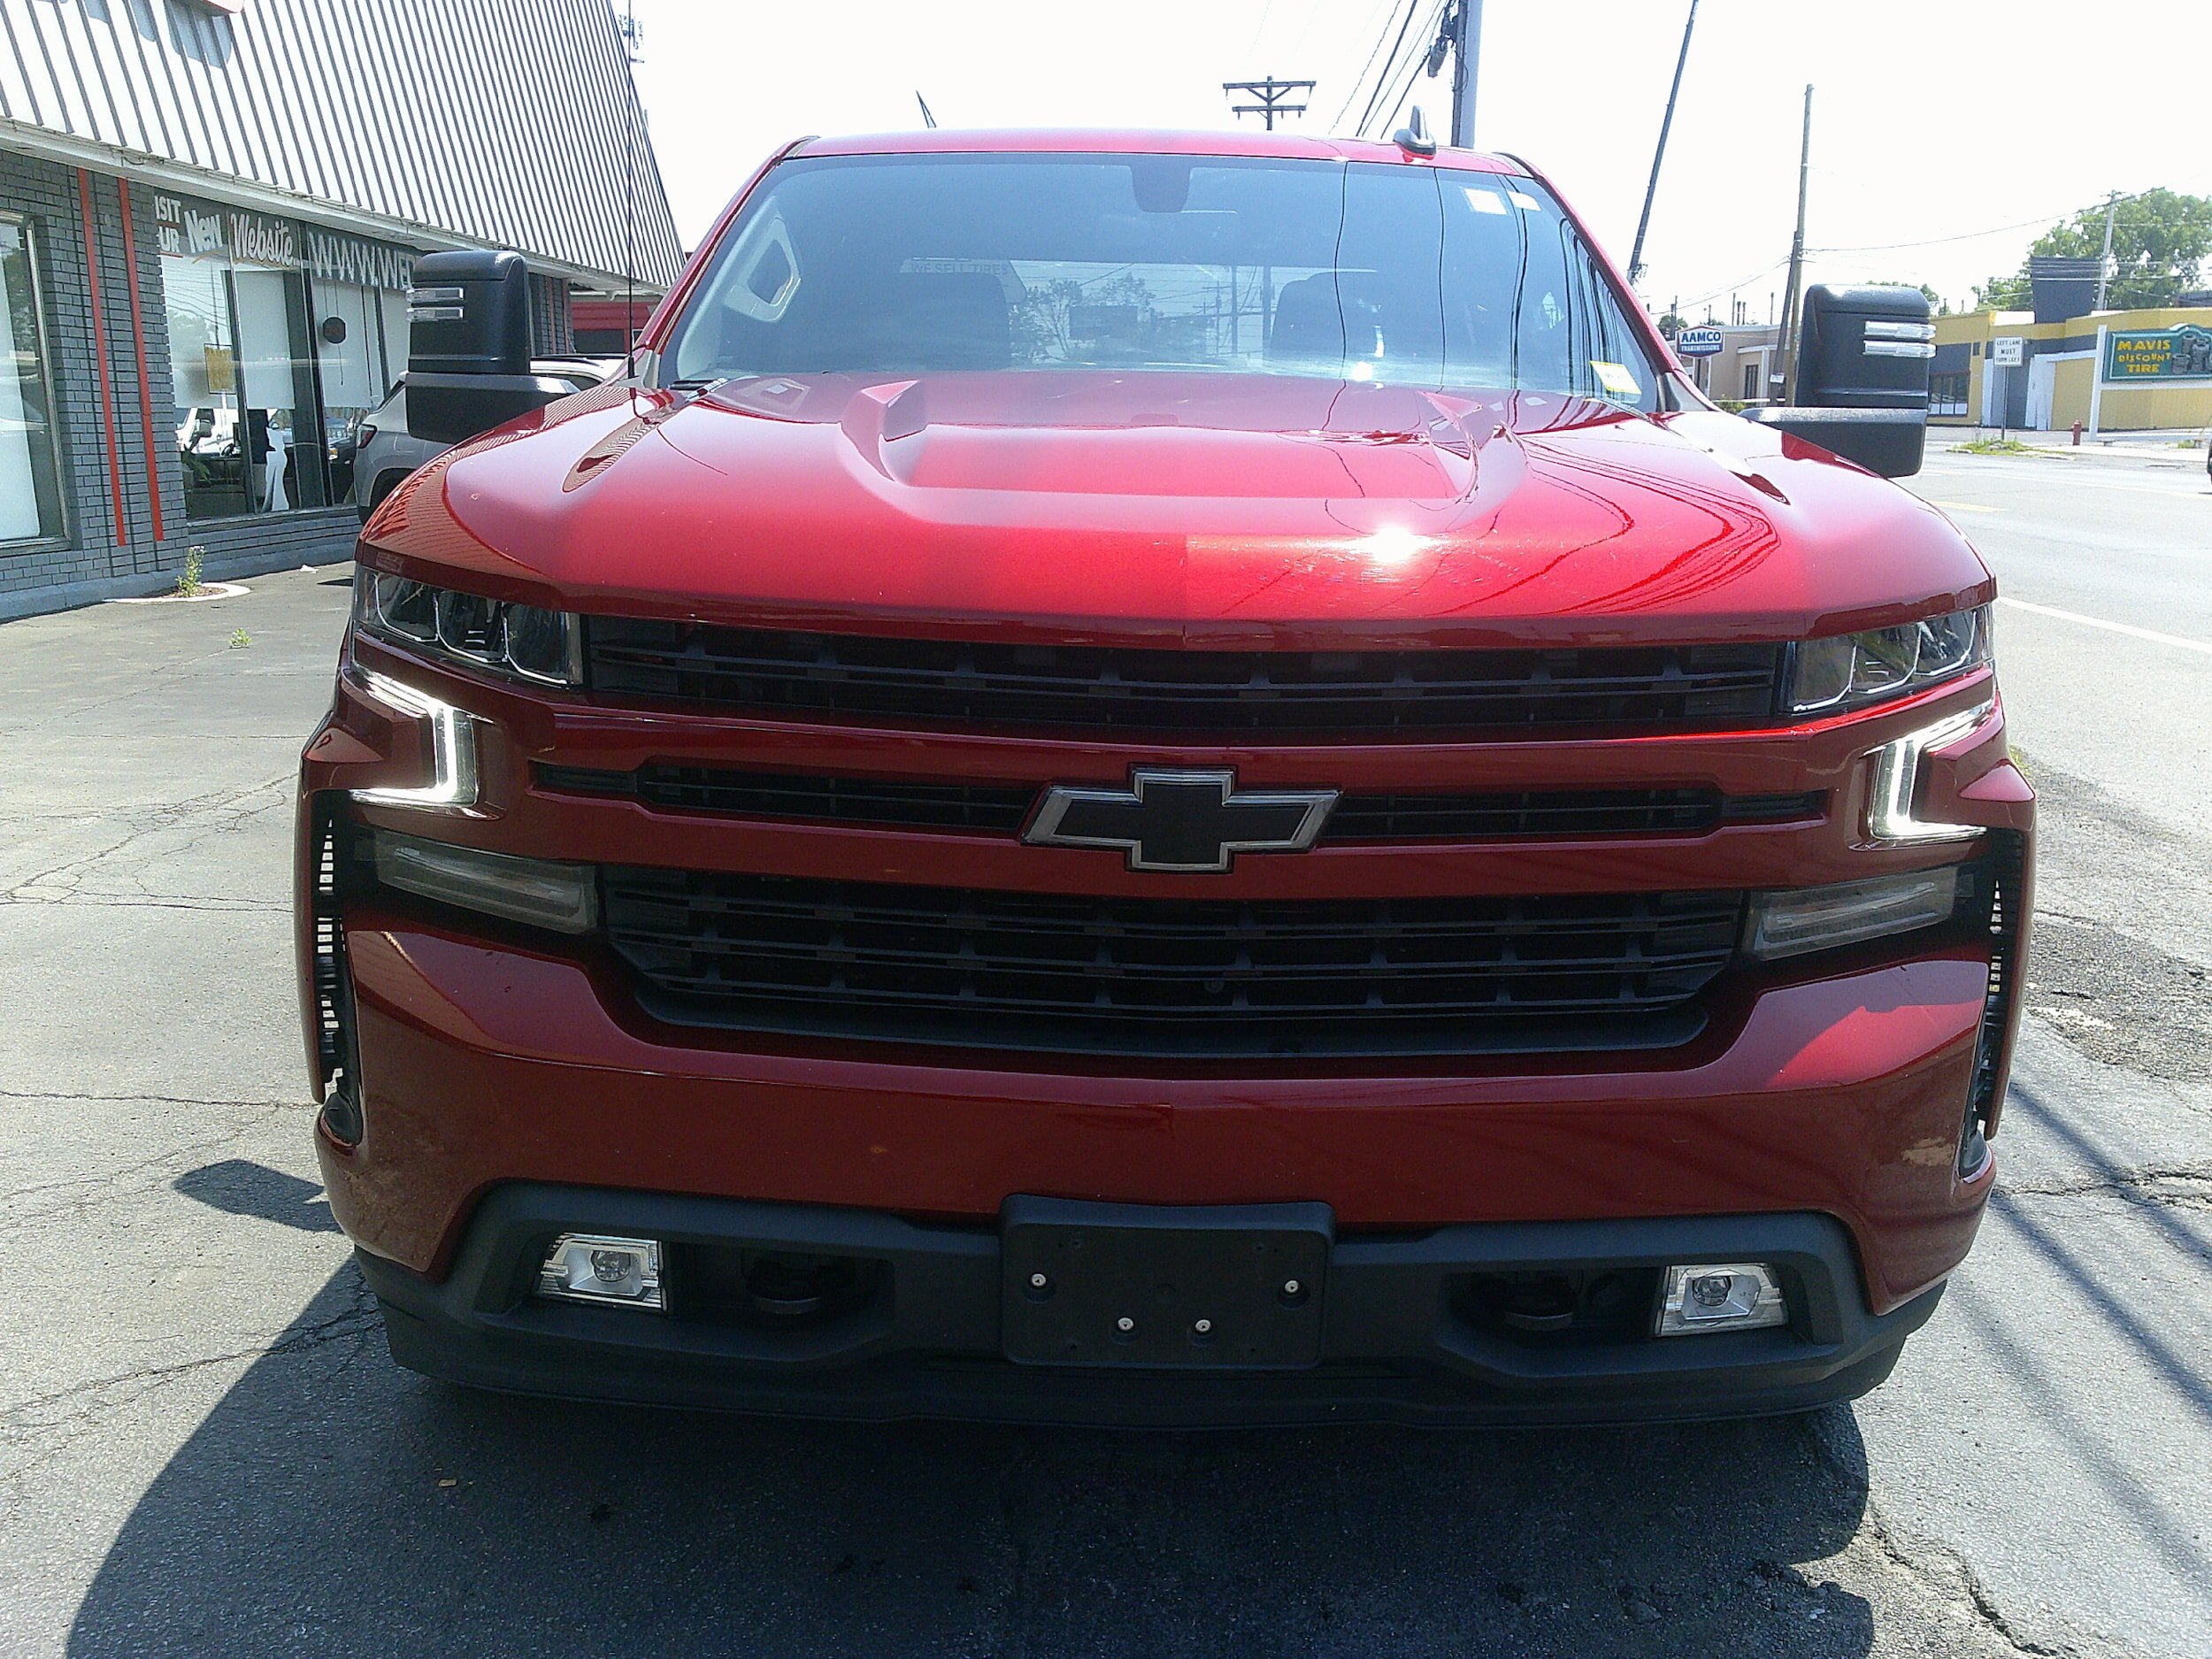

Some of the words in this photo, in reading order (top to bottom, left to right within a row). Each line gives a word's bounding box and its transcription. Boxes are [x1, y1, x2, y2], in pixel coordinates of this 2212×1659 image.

[154, 195, 181, 223] ISIT
[183, 209, 223, 253] New
[158, 226, 180, 253] UR
[1681, 332, 1721, 342] AAMCO
[2117, 340, 2171, 351] MAVIS
[2117, 352, 2171, 363] DISCOUNT
[2126, 363, 2160, 373] TIRE
